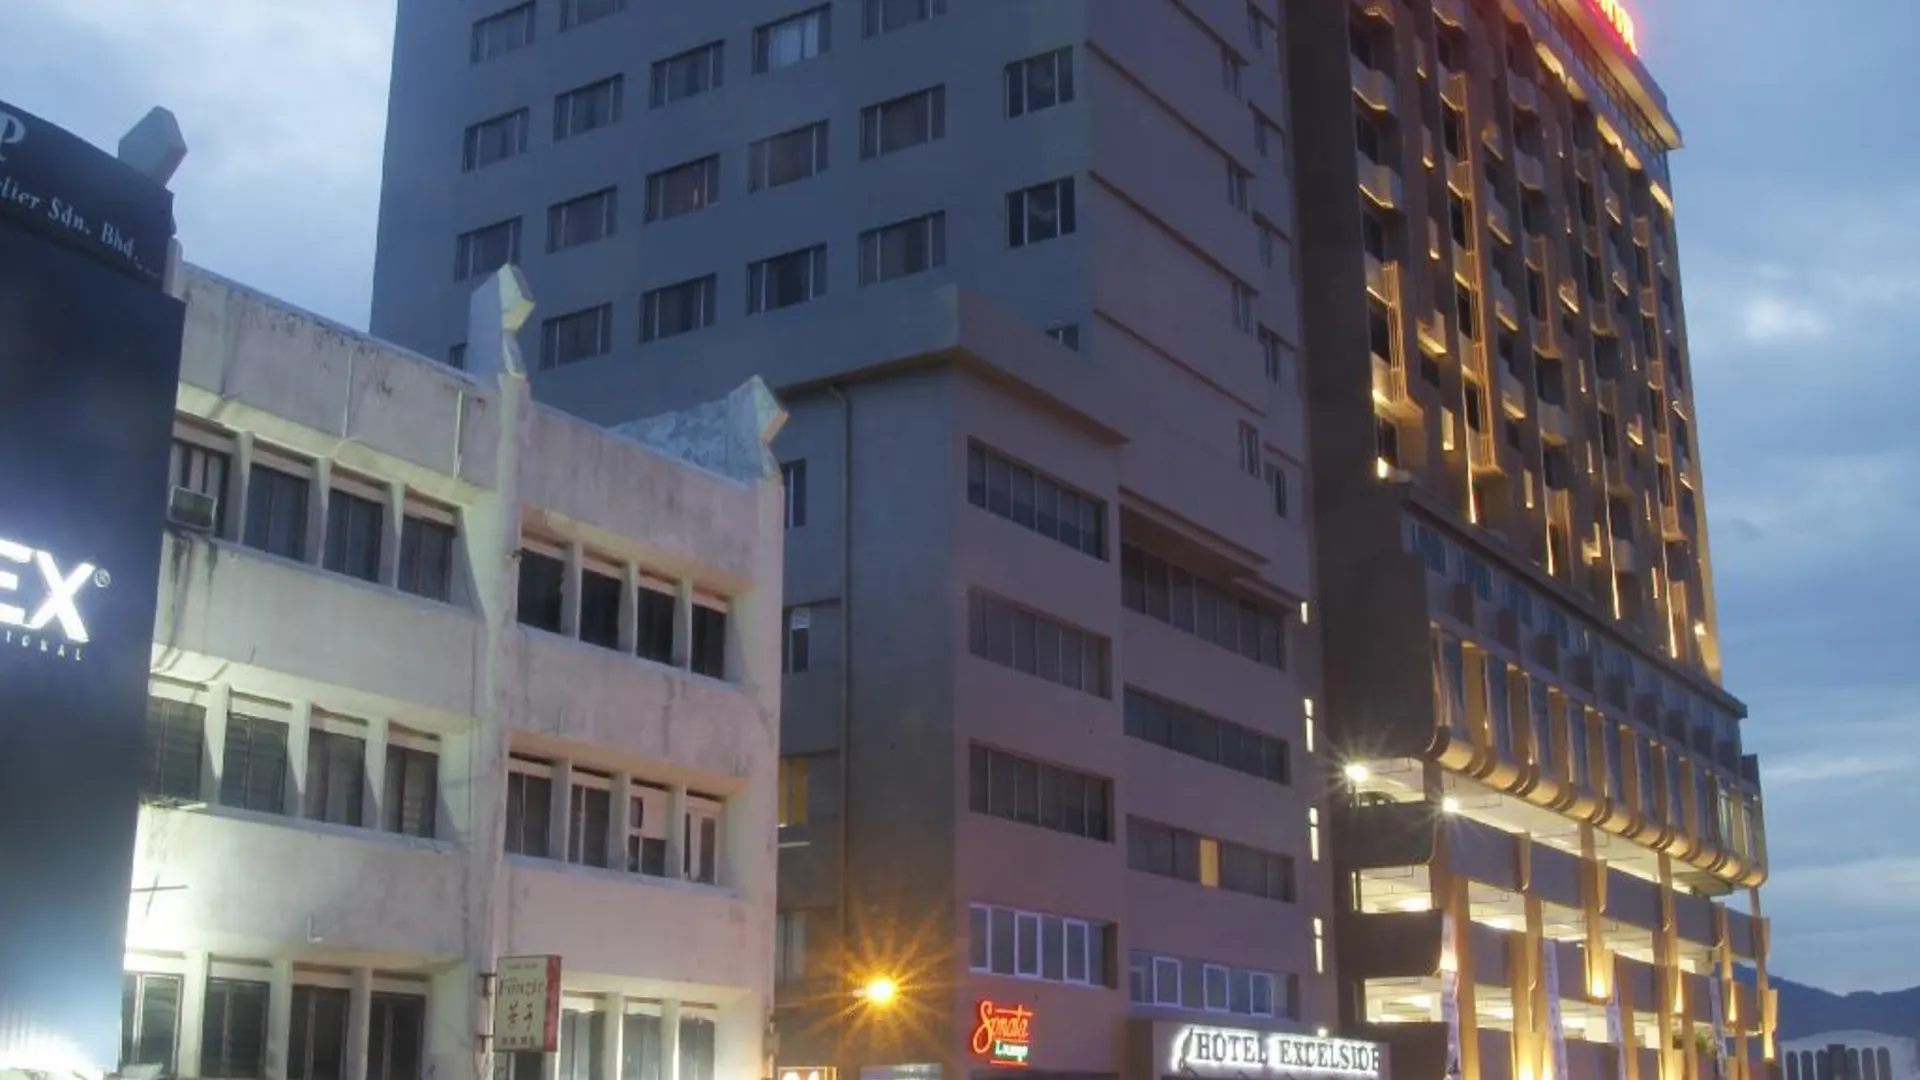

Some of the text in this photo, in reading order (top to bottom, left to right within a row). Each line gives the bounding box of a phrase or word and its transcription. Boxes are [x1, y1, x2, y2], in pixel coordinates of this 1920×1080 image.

[0, 176, 41, 210] lier
[973, 1000, 1034, 1054] Sonata
[1195, 1032, 1268, 1066] HOTEL
